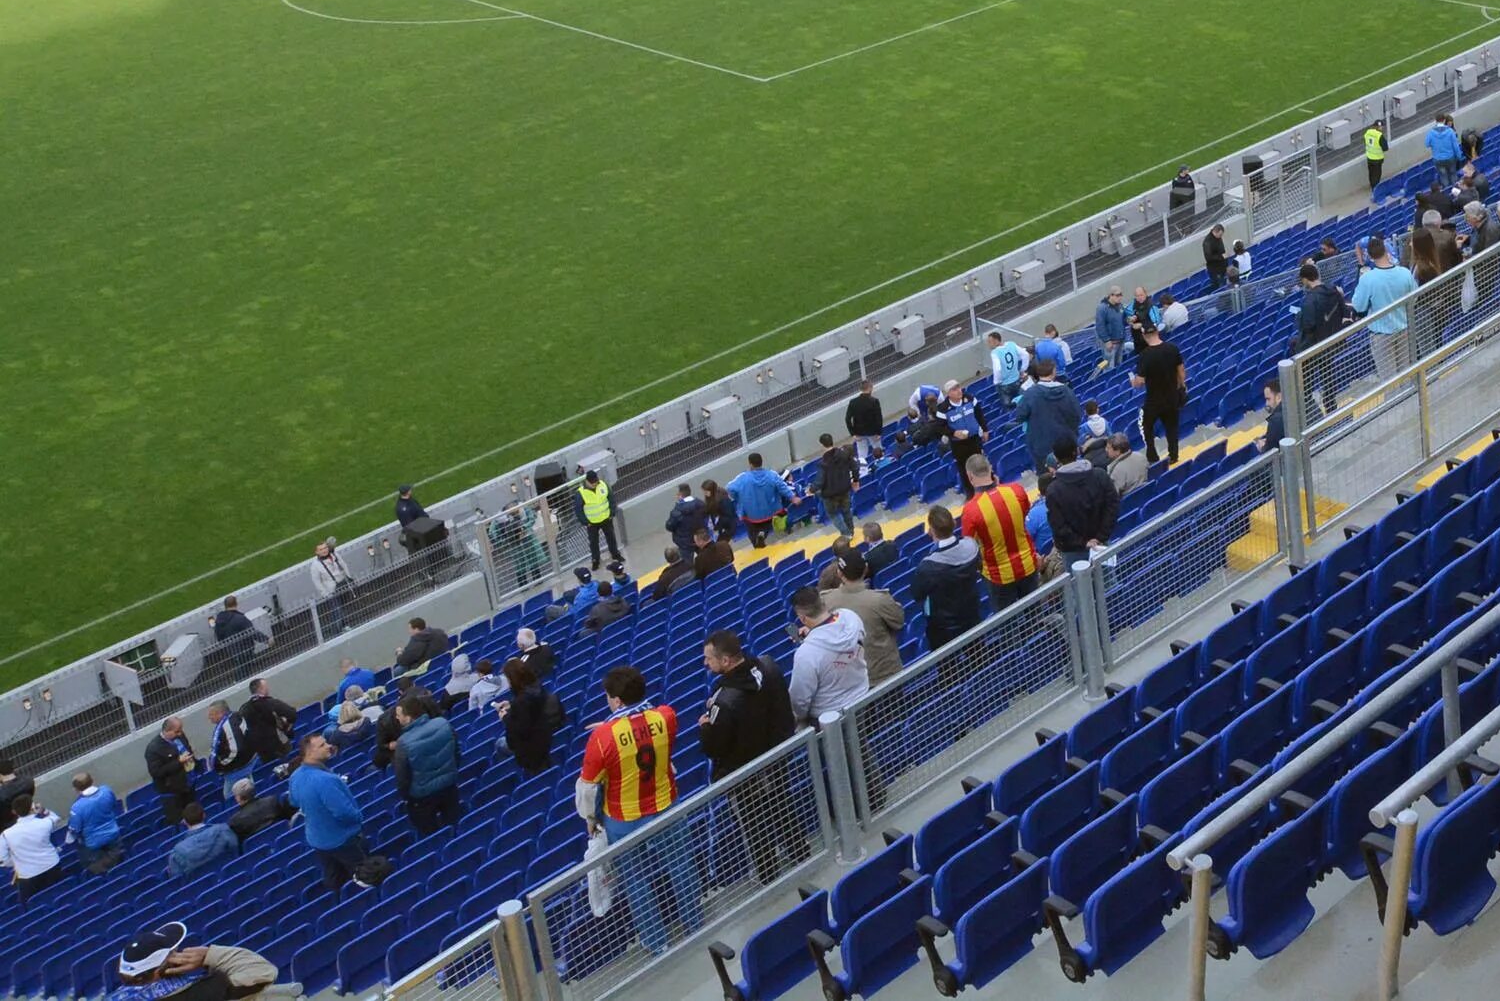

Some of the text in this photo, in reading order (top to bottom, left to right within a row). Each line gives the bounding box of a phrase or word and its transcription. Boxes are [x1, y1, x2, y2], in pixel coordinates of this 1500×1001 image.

[1004, 351, 1015, 371] 9
[619, 721, 664, 746] GICHEV
[635, 744, 657, 782] 9
